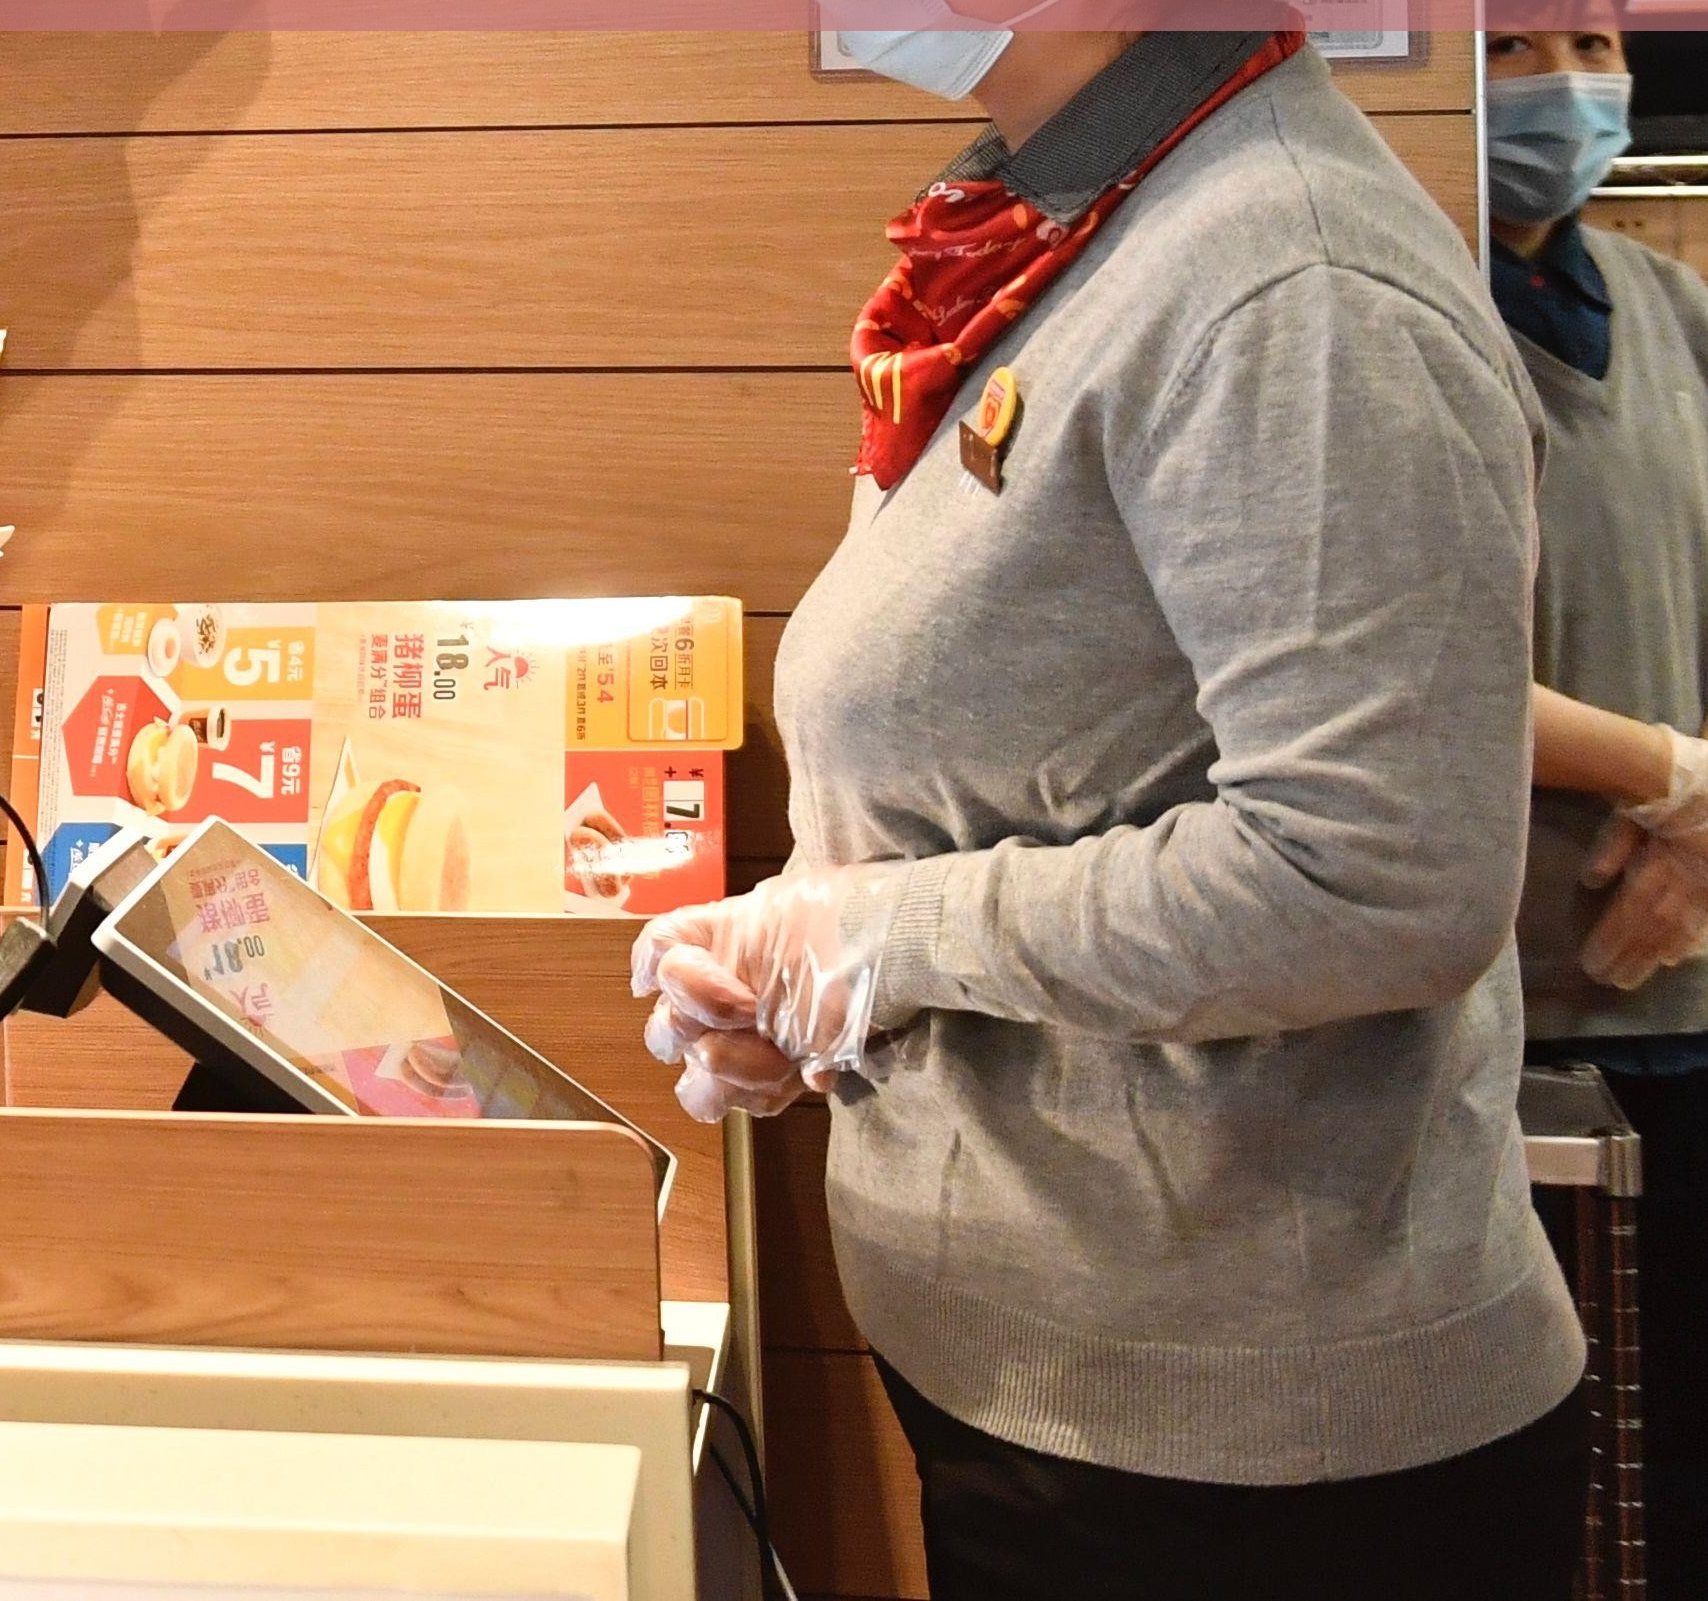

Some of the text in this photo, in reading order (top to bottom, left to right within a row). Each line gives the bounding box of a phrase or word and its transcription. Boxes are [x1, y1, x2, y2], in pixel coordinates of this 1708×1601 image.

[392, 633, 425, 719] 猪柳蛋
[483, 645, 512, 691] 人气
[280, 745, 303, 795] 省9元
